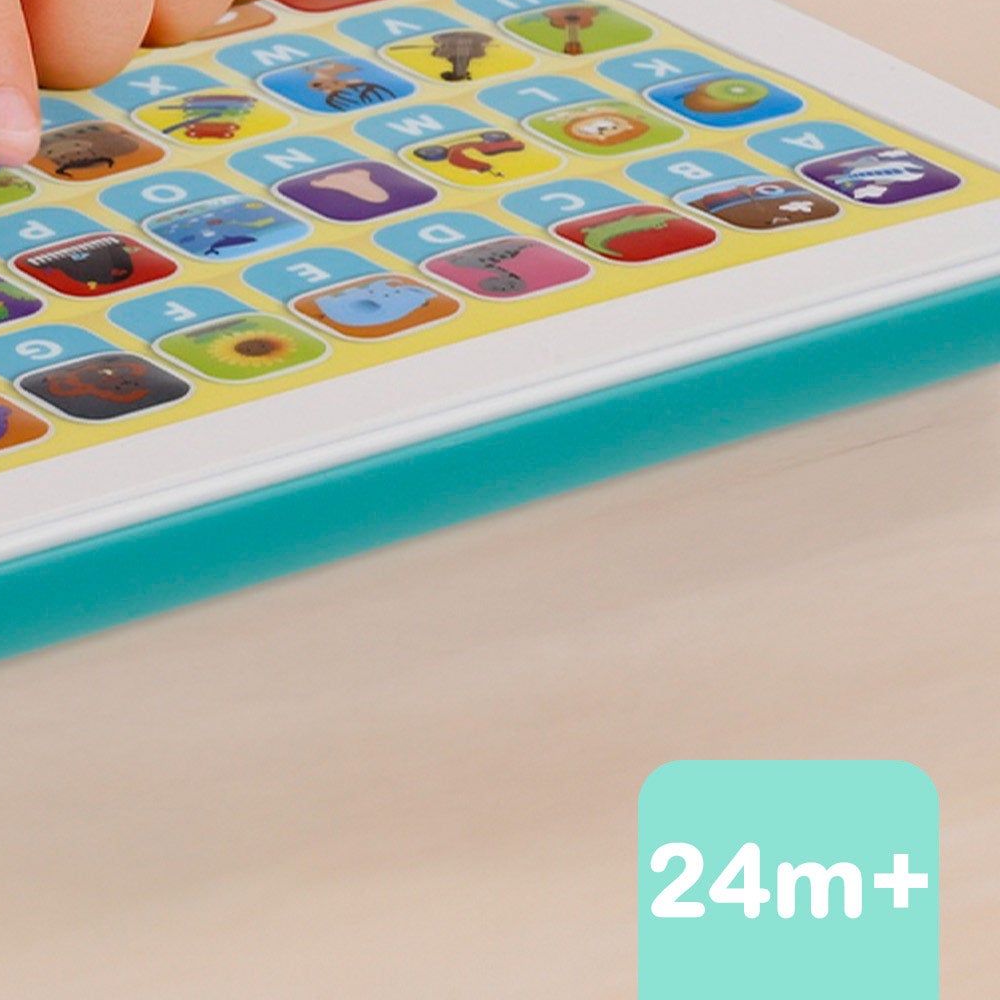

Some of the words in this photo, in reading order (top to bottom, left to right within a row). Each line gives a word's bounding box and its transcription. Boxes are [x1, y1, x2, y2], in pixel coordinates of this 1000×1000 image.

[382, 18, 421, 36] V
[250, 44, 310, 67] W
[632, 57, 682, 78] K
[126, 75, 176, 96] X
[517, 87, 559, 102] L
[385, 113, 444, 137] M
[780, 131, 825, 151] A
[262, 147, 316, 170] N
[667, 161, 714, 180] B
[140, 184, 188, 204] O
[539, 192, 586, 212] C
[18, 219, 56, 240] P
[418, 224, 466, 245] D
[287, 262, 331, 282] E
[165, 301, 197, 321] F
[14, 339, 63, 360] G
